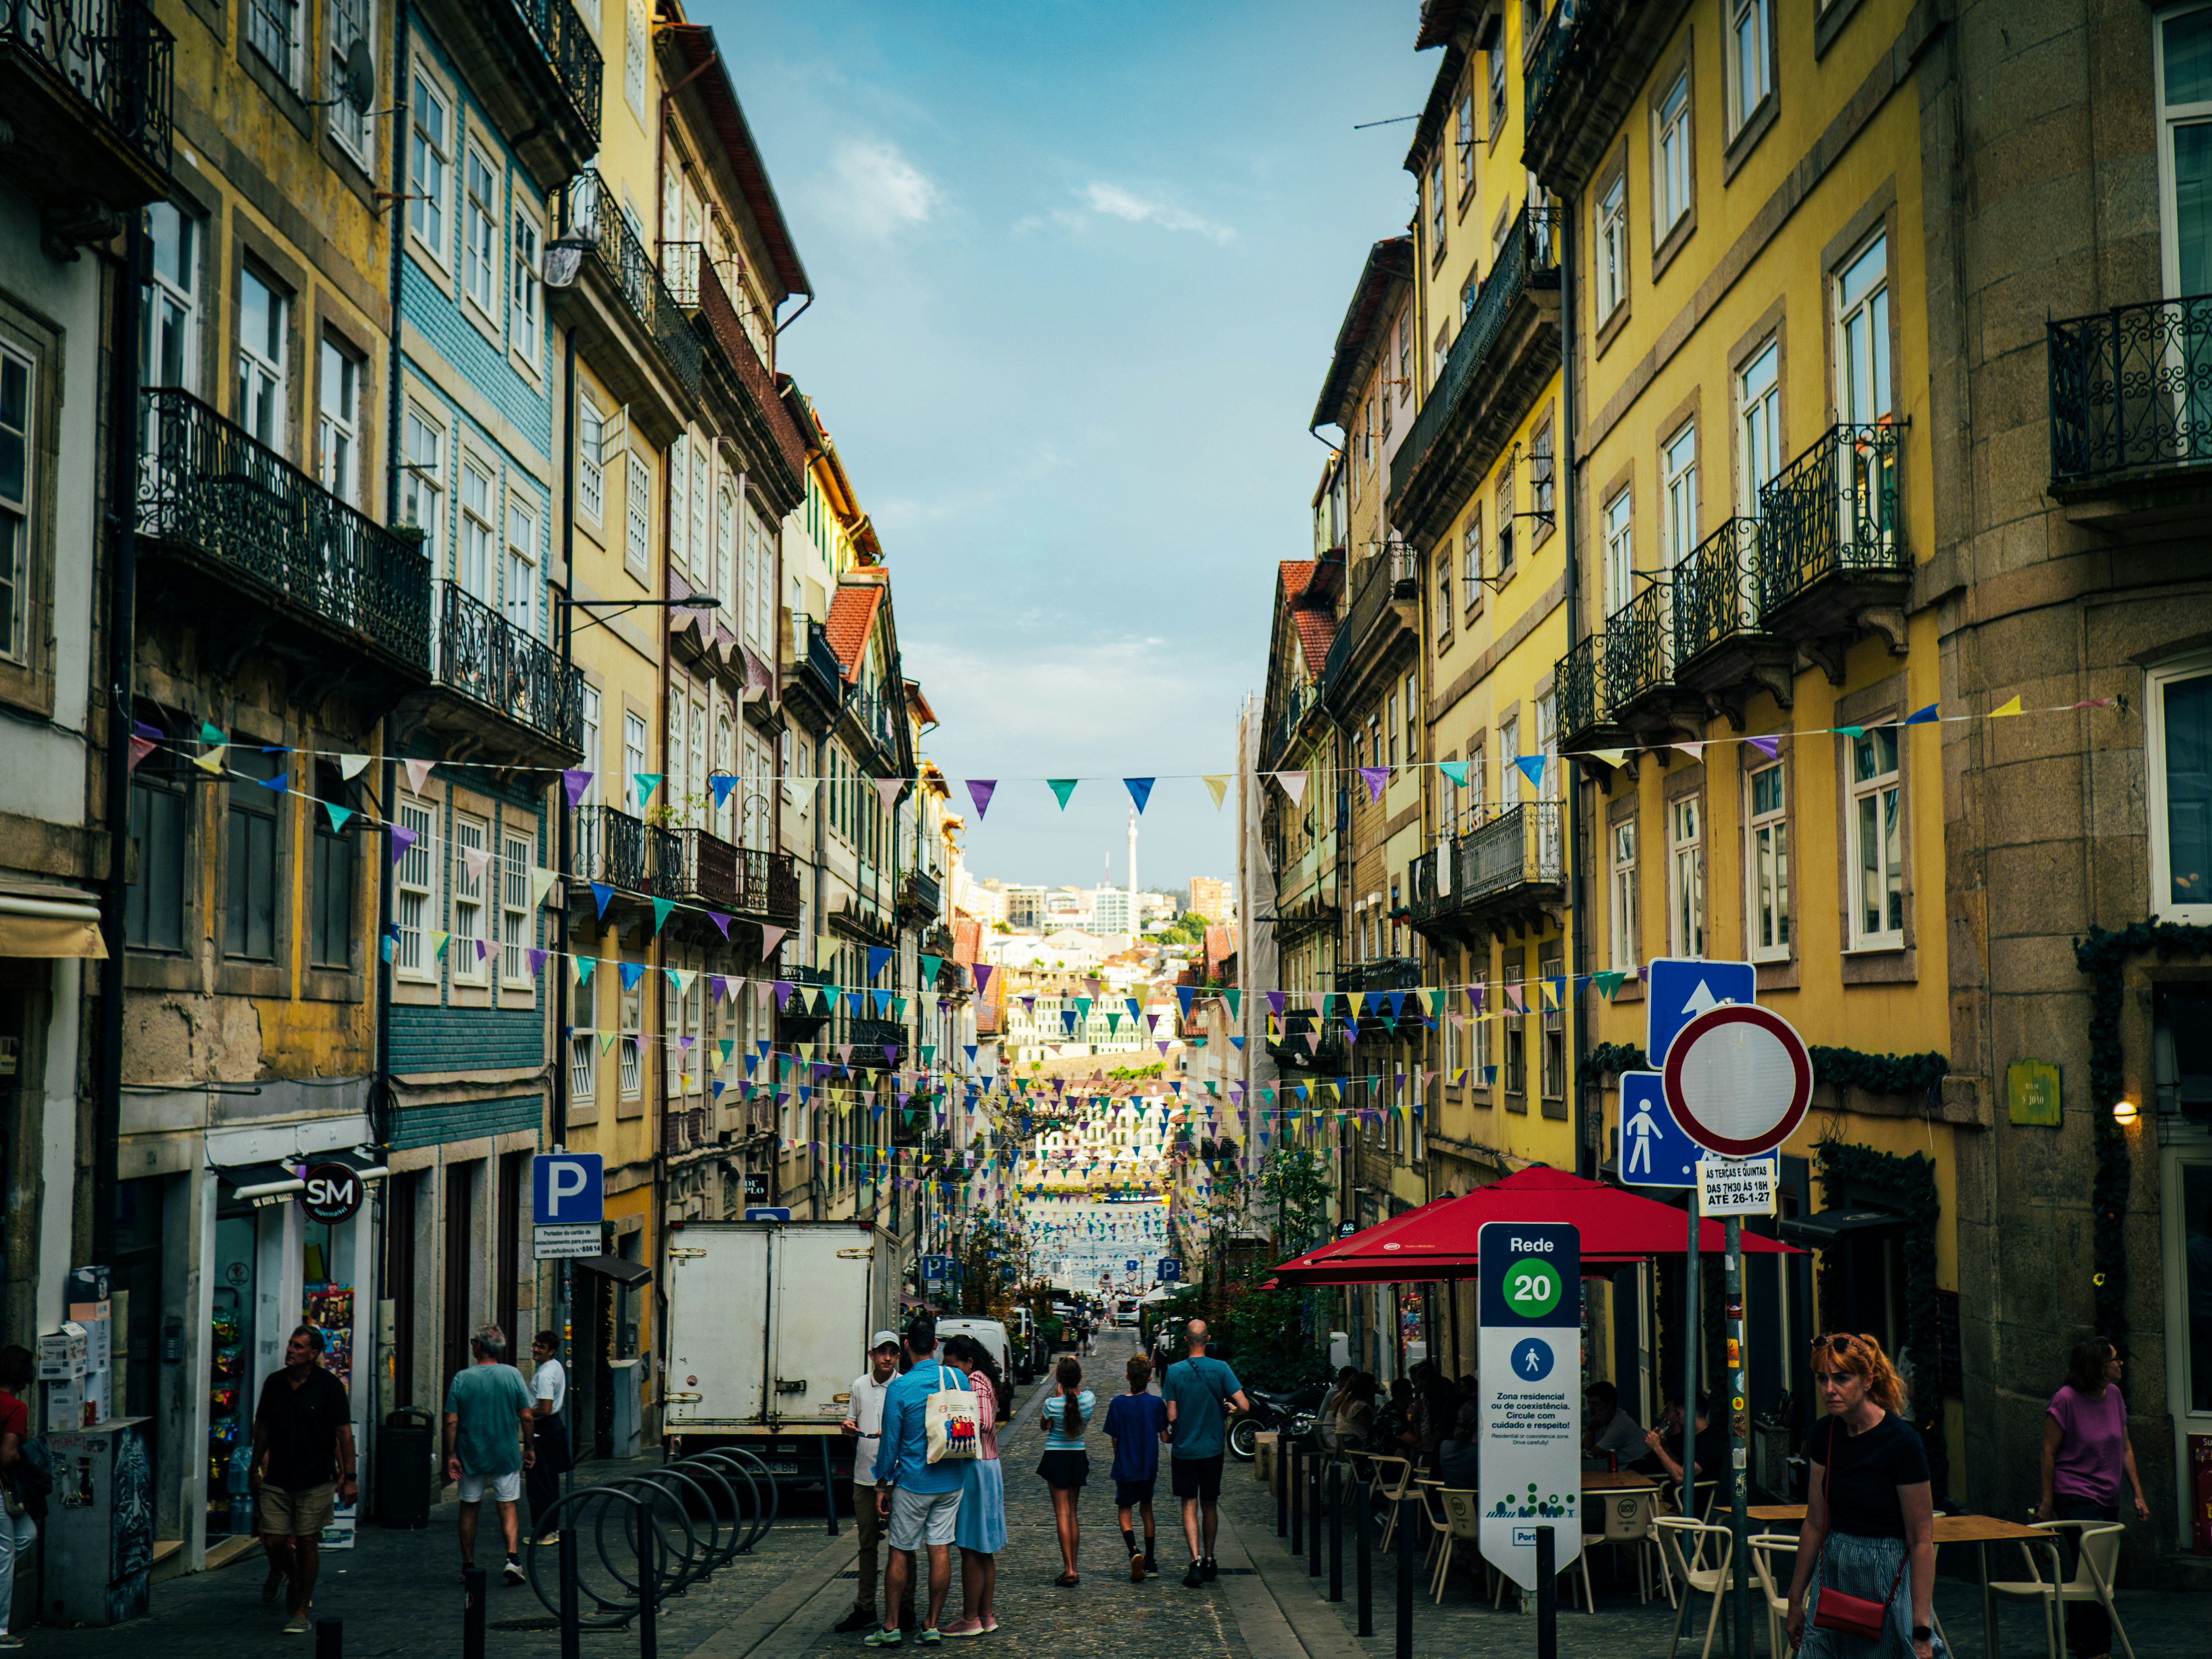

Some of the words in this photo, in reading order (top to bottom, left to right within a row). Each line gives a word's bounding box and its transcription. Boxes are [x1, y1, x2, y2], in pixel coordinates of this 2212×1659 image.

[1706, 1168, 1714, 1179] ÀS
[1715, 1167, 1736, 1180] TERÇAS
[1738, 1168, 1741, 1177] E
[1743, 1166, 1767, 1177] QUINTAS
[306, 1179, 353, 1205] SM
[548, 1162, 587, 1216] P
[1707, 1184, 1720, 1193] DAS
[1723, 1182, 1741, 1192] 7H30
[1743, 1180, 1752, 1191] ÀS
[1755, 1181, 1768, 1190] 18H
[1708, 1191, 1729, 1205] ATÉ
[1732, 1192, 1770, 1203] 26-1-27
[1511, 1237, 1554, 1252] Rede
[1164, 1262, 1175, 1278] P
[1514, 1275, 1551, 1301] 20
[1534, 1422, 1570, 1430] respeito!
[1518, 1532, 1536, 1541] Port
